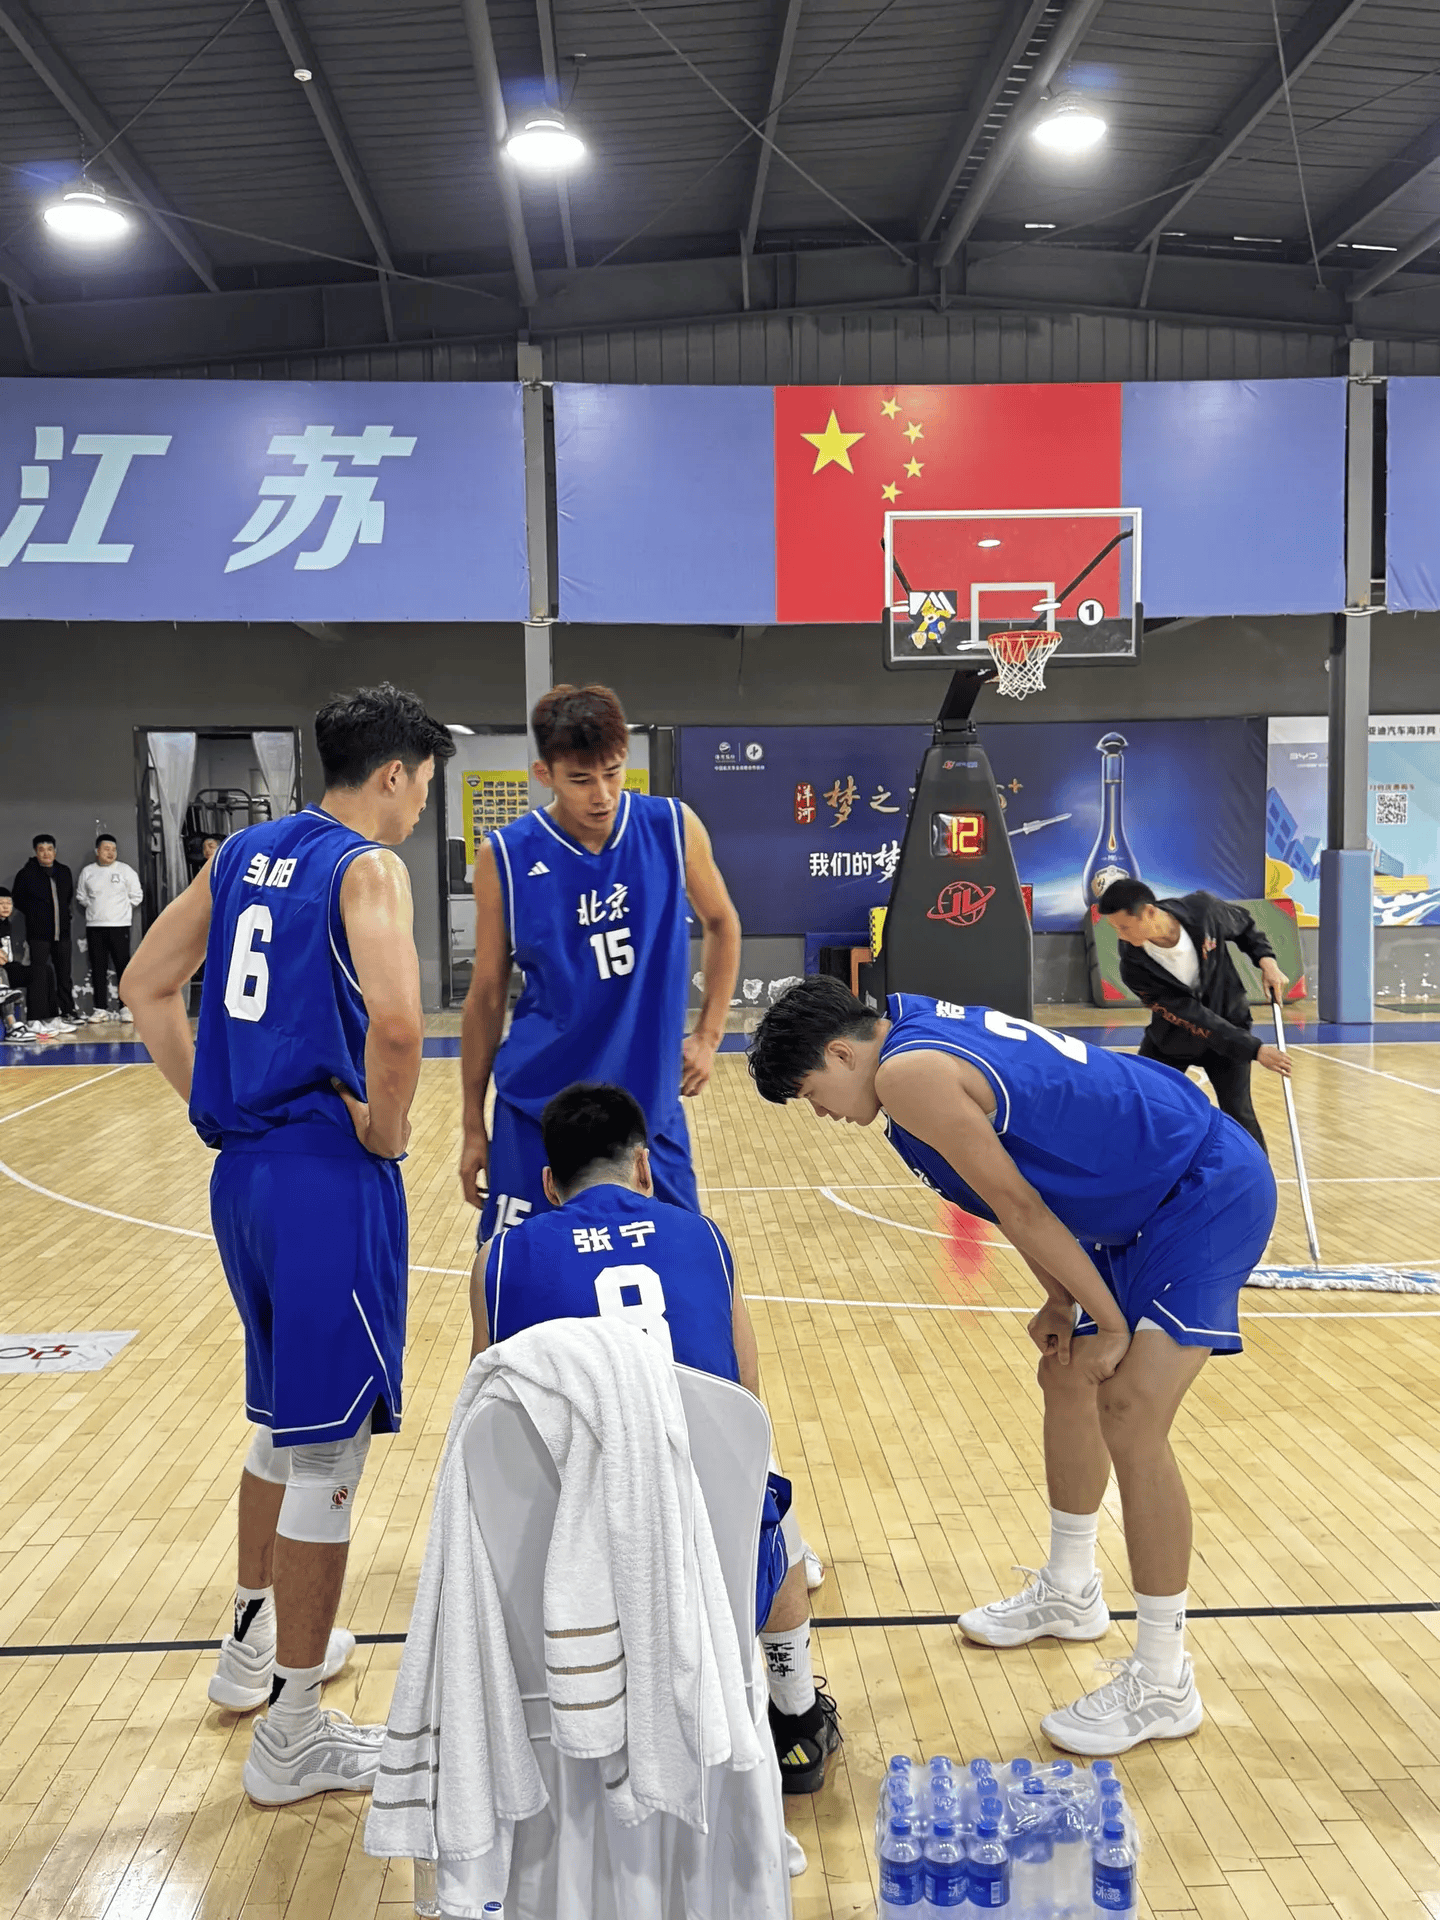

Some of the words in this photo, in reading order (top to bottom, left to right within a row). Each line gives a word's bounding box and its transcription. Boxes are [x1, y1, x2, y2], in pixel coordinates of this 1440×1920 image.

[0, 425, 418, 573] 江苏
[1085, 604, 1095, 621] 1
[823, 775, 917, 828] 梦之
[951, 817, 979, 853] 12
[576, 883, 630, 926] 北京
[224, 904, 273, 1022] 6
[588, 927, 636, 980] 15
[572, 1221, 657, 1254] 张宁
